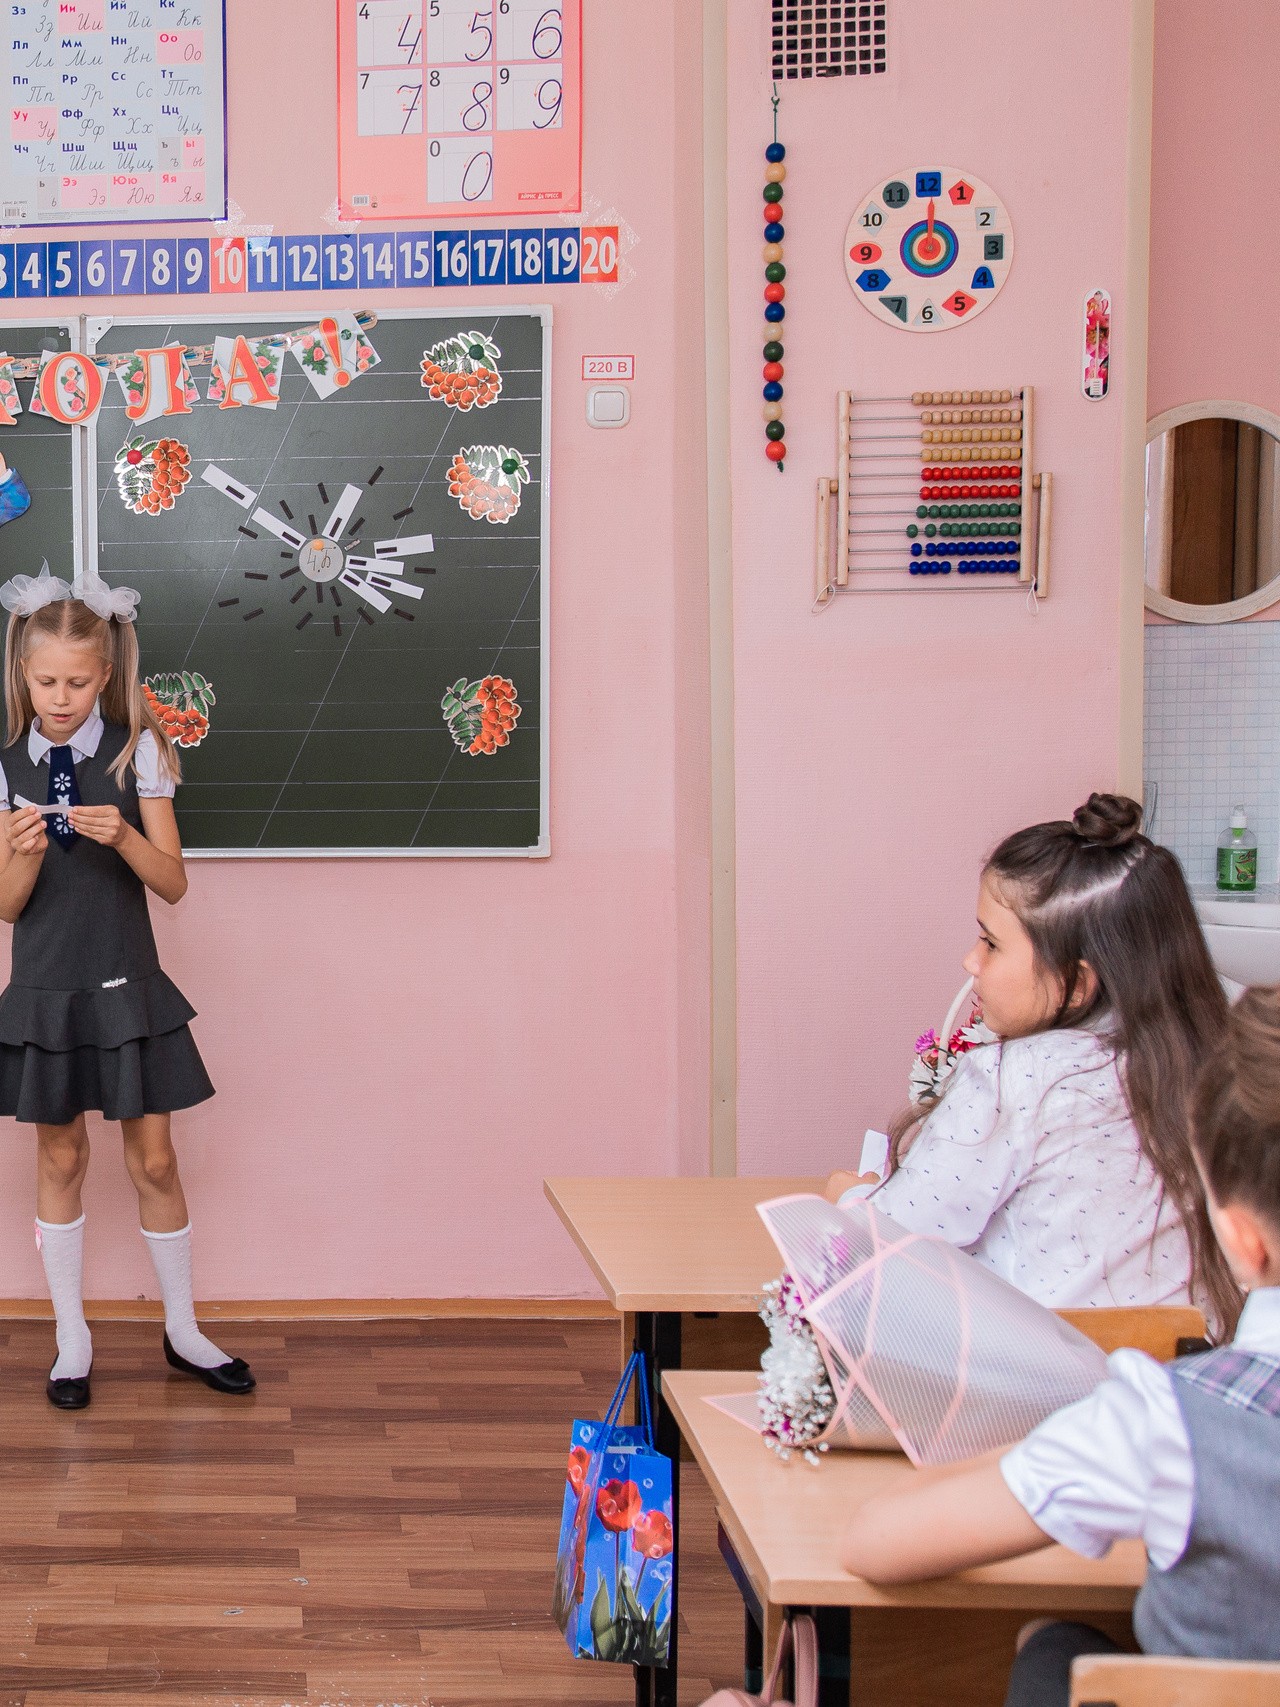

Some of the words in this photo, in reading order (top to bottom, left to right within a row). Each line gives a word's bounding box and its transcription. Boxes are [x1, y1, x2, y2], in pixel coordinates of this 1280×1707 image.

[359, 4, 370, 19] 4
[430, 0, 440, 16] 5
[500, 0, 509, 14] 6
[398, 15, 422, 64] 4
[465, 12, 492, 61] 5
[533, 9, 562, 59] 6
[360, 74, 369, 89] 7
[430, 71, 440, 87] 8
[500, 68, 509, 84] 9
[397, 84, 422, 134] 7
[463, 82, 492, 131] 8
[533, 79, 562, 128] 9
[430, 141, 440, 157] 0
[462, 152, 492, 201] 0
[886, 188, 905, 202] 11
[918, 178, 938, 192] 12
[957, 186, 966, 200] 1
[863, 213, 882, 226] 10
[980, 212, 990, 226] 2
[861, 246, 872, 260] 9
[988, 241, 999, 255] 3
[22, 253, 41, 288] 4
[55, 252, 71, 288] 5
[87, 250, 105, 287] 6
[120, 250, 137, 286] 7
[152, 248, 169, 285] 8
[184, 248, 202, 284] 9
[214, 247, 242, 284] 10
[252, 247, 279, 283] 11
[288, 245, 318, 282] 12
[325, 244, 354, 281] 13
[362, 243, 393, 280] 14
[400, 241, 429, 279] 15
[437, 240, 467, 278] 16
[473, 239, 503, 277] 17
[510, 238, 541, 276] 18
[547, 237, 578, 275] 19
[583, 236, 616, 274] 20
[866, 274, 879, 288] 8
[976, 272, 988, 286] 4
[891, 300, 902, 313] 7
[922, 306, 933, 320] 6
[954, 296, 965, 310] 5
[589, 362, 612, 372] 220
[618, 362, 627, 372] В
